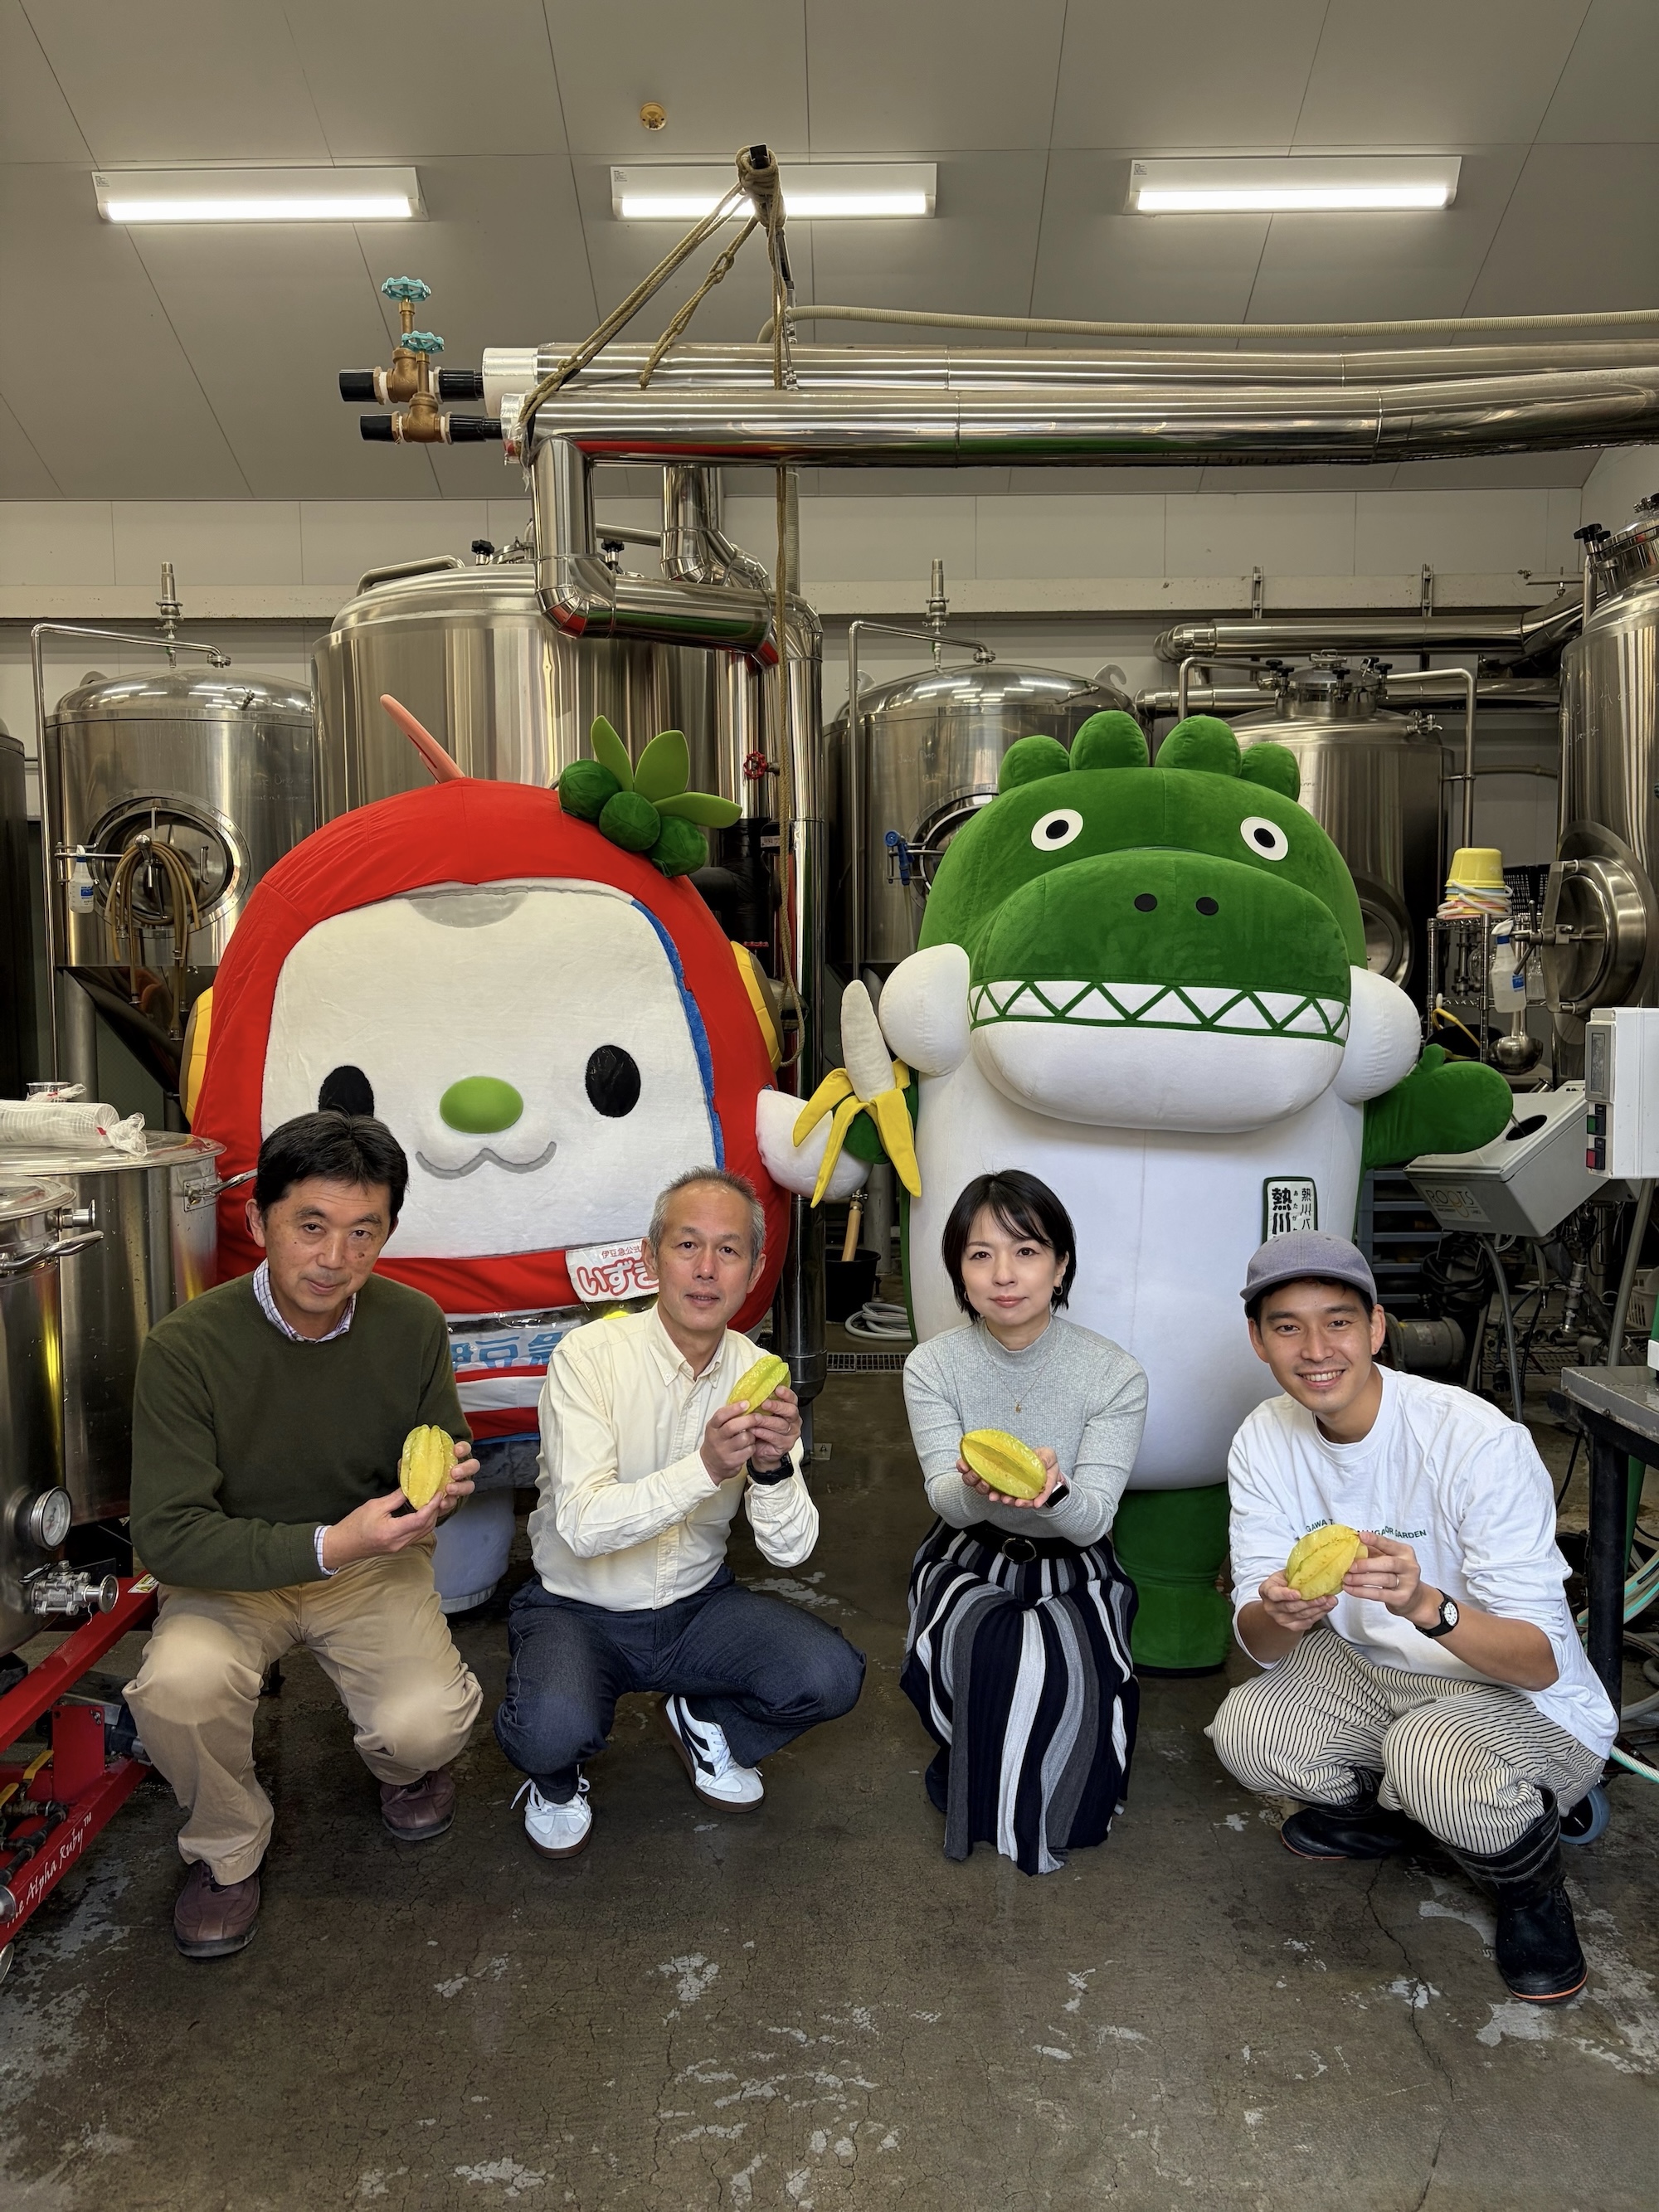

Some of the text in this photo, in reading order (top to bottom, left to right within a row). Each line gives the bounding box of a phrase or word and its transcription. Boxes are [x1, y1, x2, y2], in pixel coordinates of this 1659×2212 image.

[1272, 1187, 1292, 1237] 熱川
[1305, 1519, 1327, 1533] GAWA
[27, 1860, 57, 1903] Alpha
